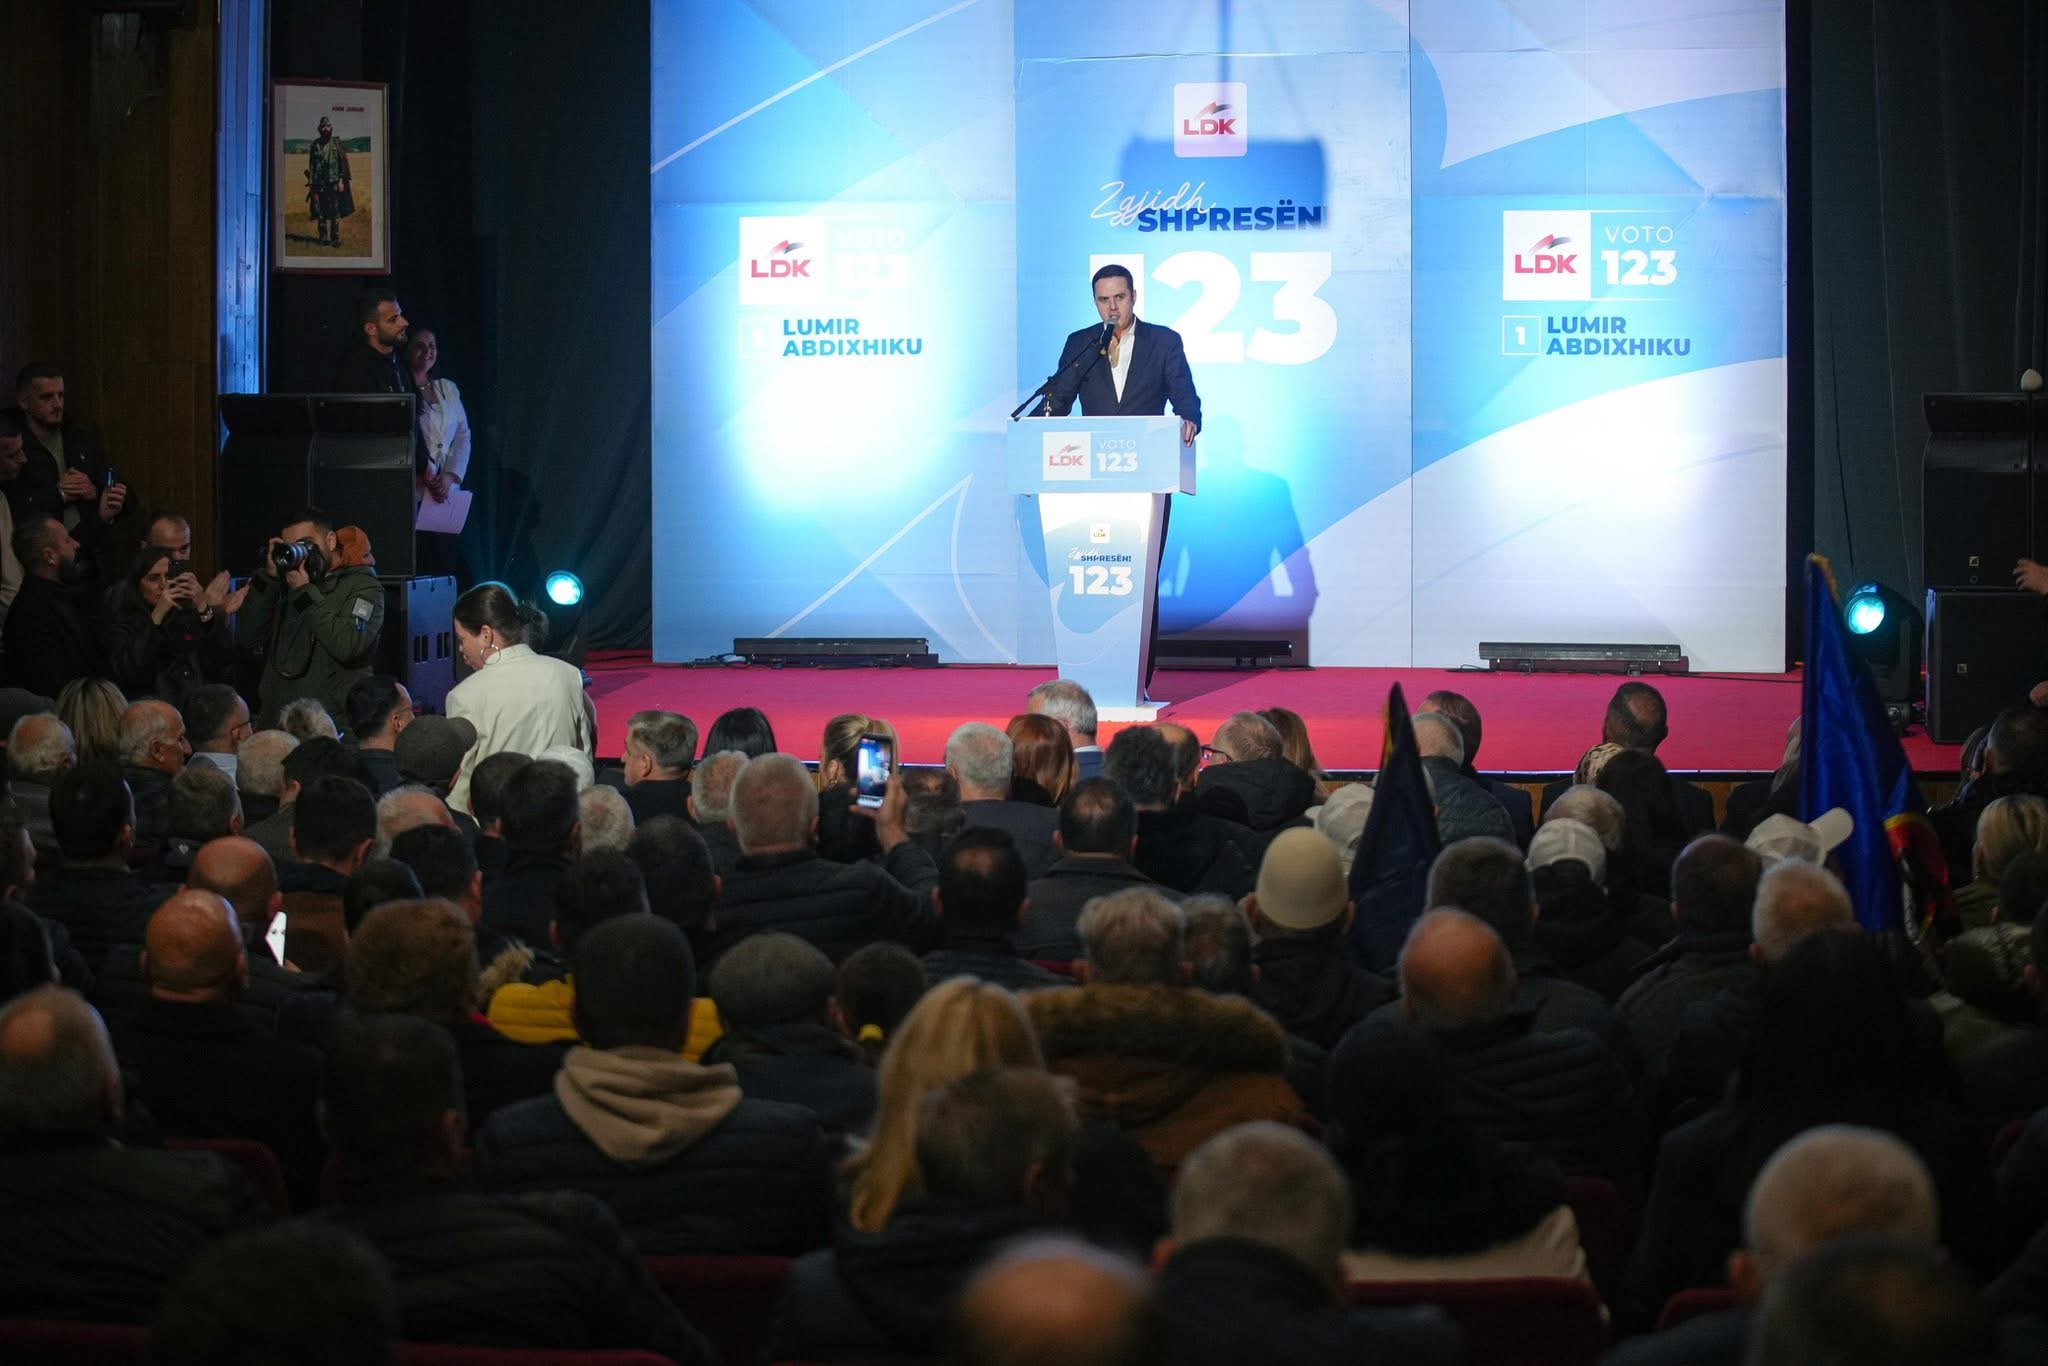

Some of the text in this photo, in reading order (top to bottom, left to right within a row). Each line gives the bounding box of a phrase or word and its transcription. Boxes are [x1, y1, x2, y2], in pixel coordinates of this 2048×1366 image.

[1183, 119, 1237, 135] LDK
[1089, 180, 1216, 227] Zgjidh
[1604, 225, 1674, 244] VOTO
[751, 259, 812, 278] LDK
[1514, 254, 1578, 274] LDK
[1601, 249, 1678, 287] 123
[783, 318, 860, 336] LUMIR
[1547, 316, 1627, 335] LUMIR
[1514, 325, 1527, 346] 1
[782, 338, 923, 357] ABDIXHIKU
[1546, 338, 1691, 357] ABDIXHIKU
[1098, 439, 1137, 450] VOTO
[1049, 455, 1084, 467] LDK
[1096, 452, 1139, 472] 123
[1069, 565, 1133, 595] 123
